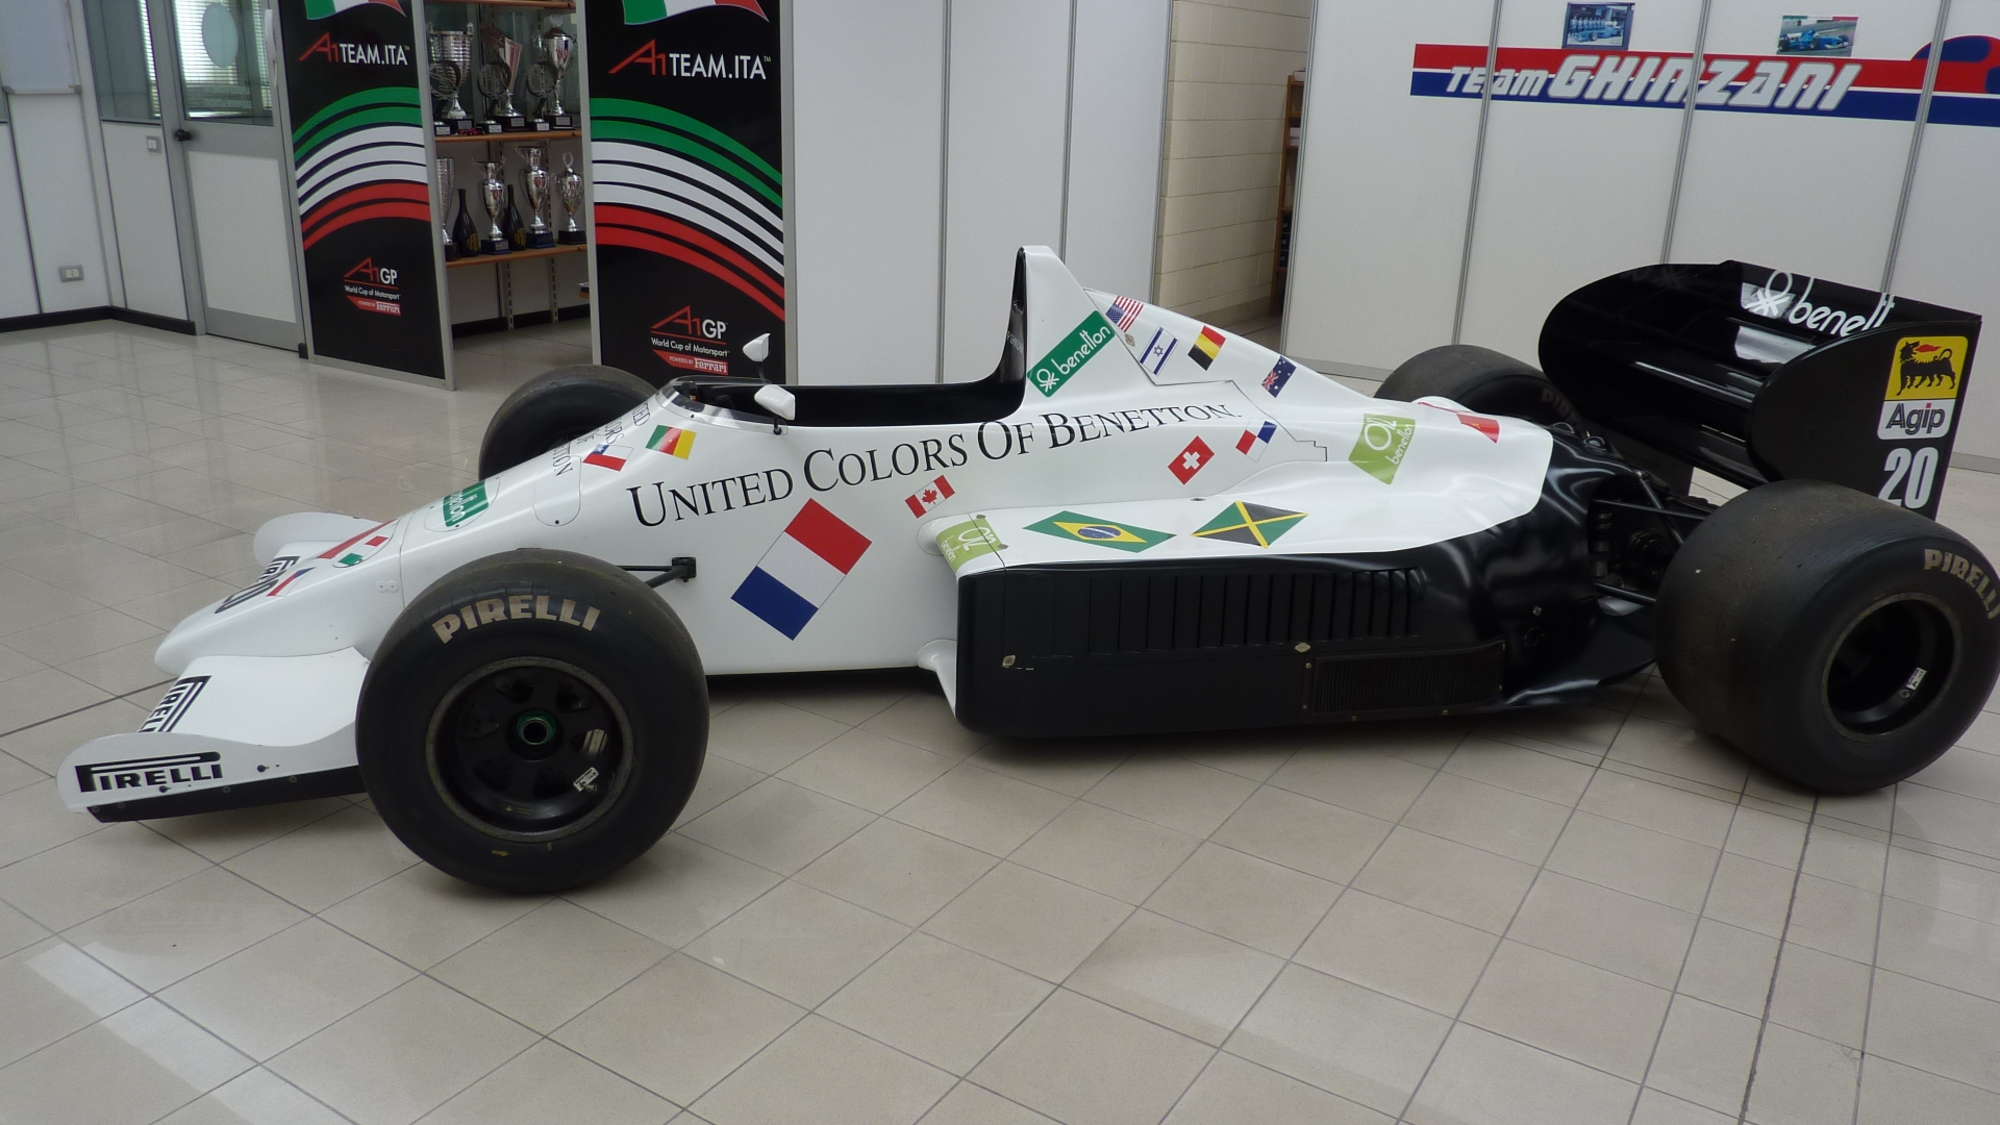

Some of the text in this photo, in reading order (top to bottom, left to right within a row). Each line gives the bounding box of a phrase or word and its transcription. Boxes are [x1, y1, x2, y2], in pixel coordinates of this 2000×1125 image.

[651, 337, 728, 358] World Cup of Motorsport
[695, 358, 728, 374] Ferrari
[1050, 326, 1111, 375] benetton
[1885, 402, 1946, 435] Agip
[626, 468, 794, 527] UNITED
[803, 433, 968, 492] COLORS
[1878, 446, 1939, 509] 20
[432, 595, 600, 644] PIRELLI
[75, 751, 223, 793] PIRELLI
